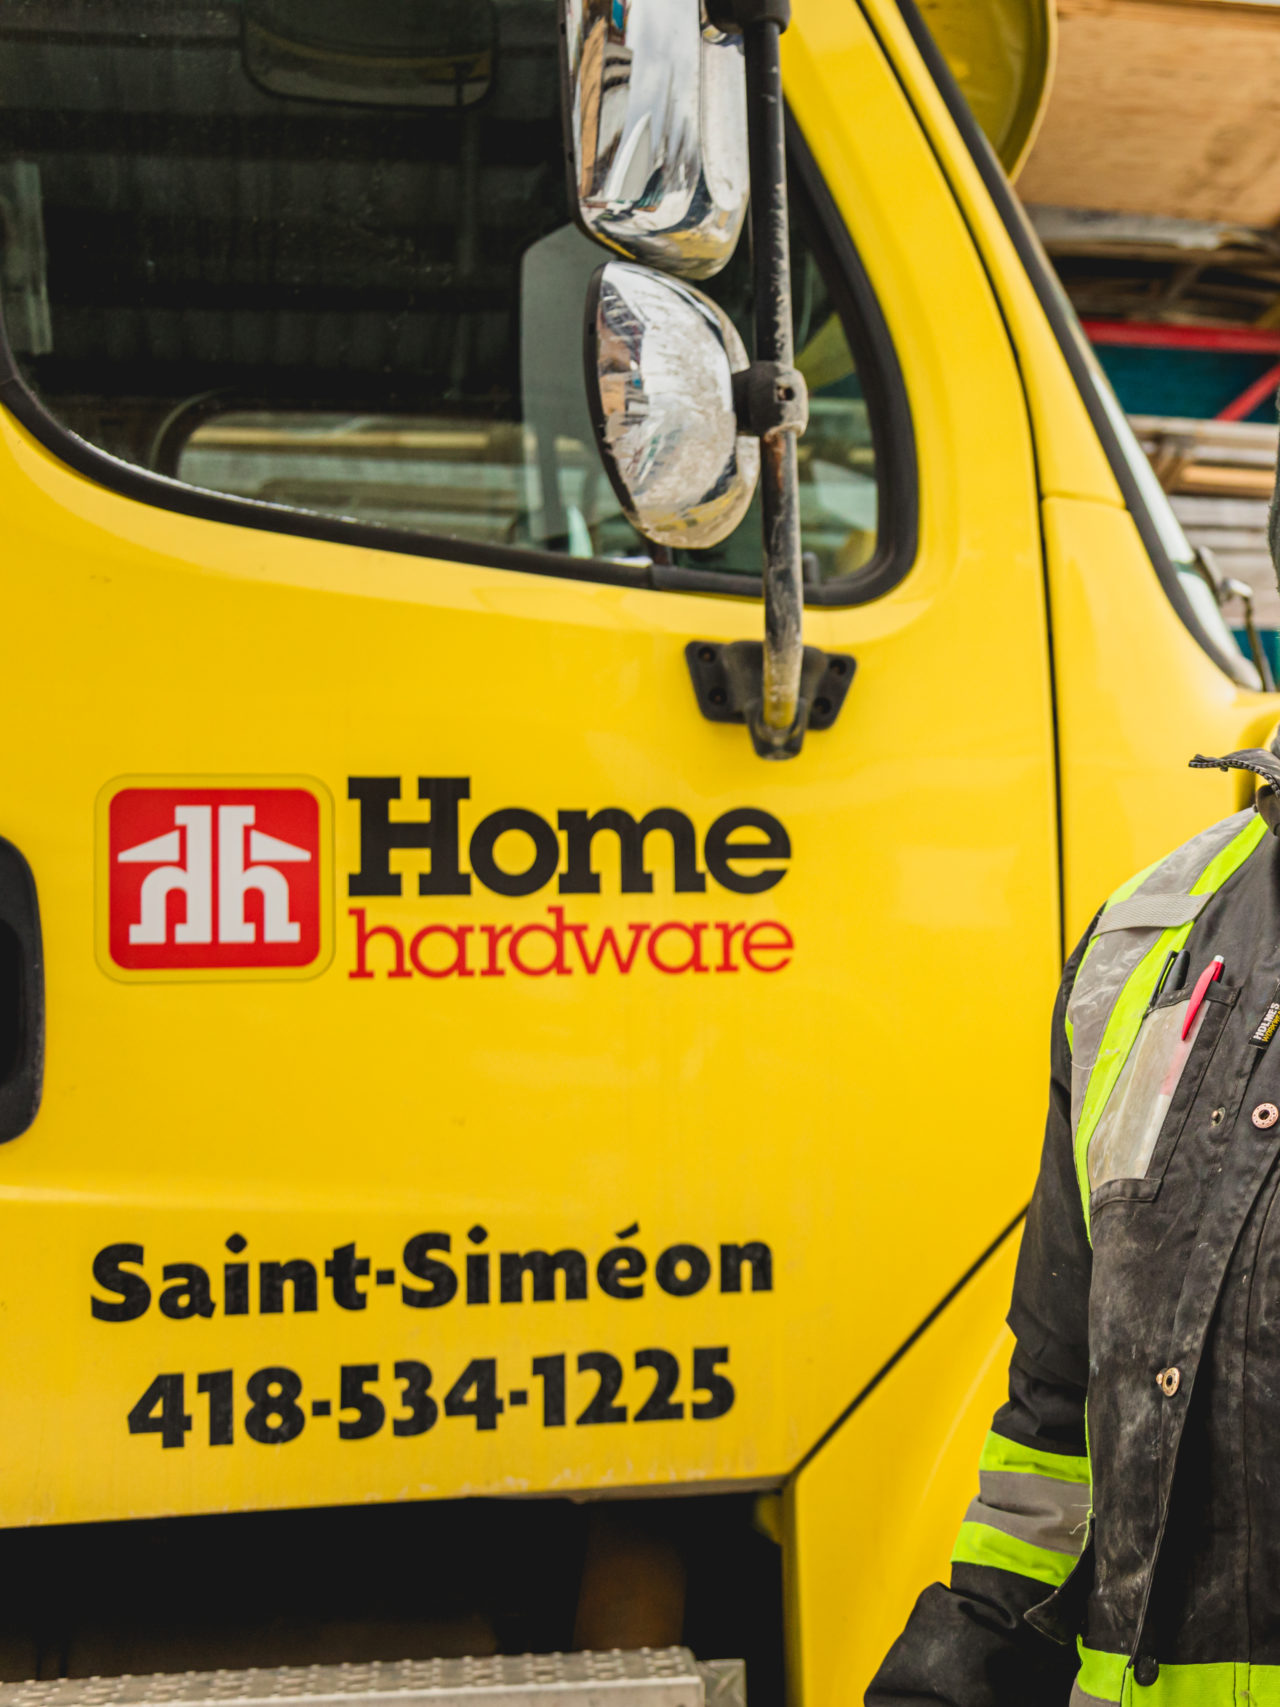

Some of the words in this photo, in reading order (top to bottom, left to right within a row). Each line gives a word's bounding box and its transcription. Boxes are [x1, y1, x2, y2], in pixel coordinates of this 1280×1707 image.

[347, 775, 792, 897] Home
[347, 906, 795, 980] hardware
[1252, 1002, 1280, 1041] HOLMES
[90, 1222, 774, 1324] Saint-Siméon
[126, 1345, 737, 1450] 418-534-1225
